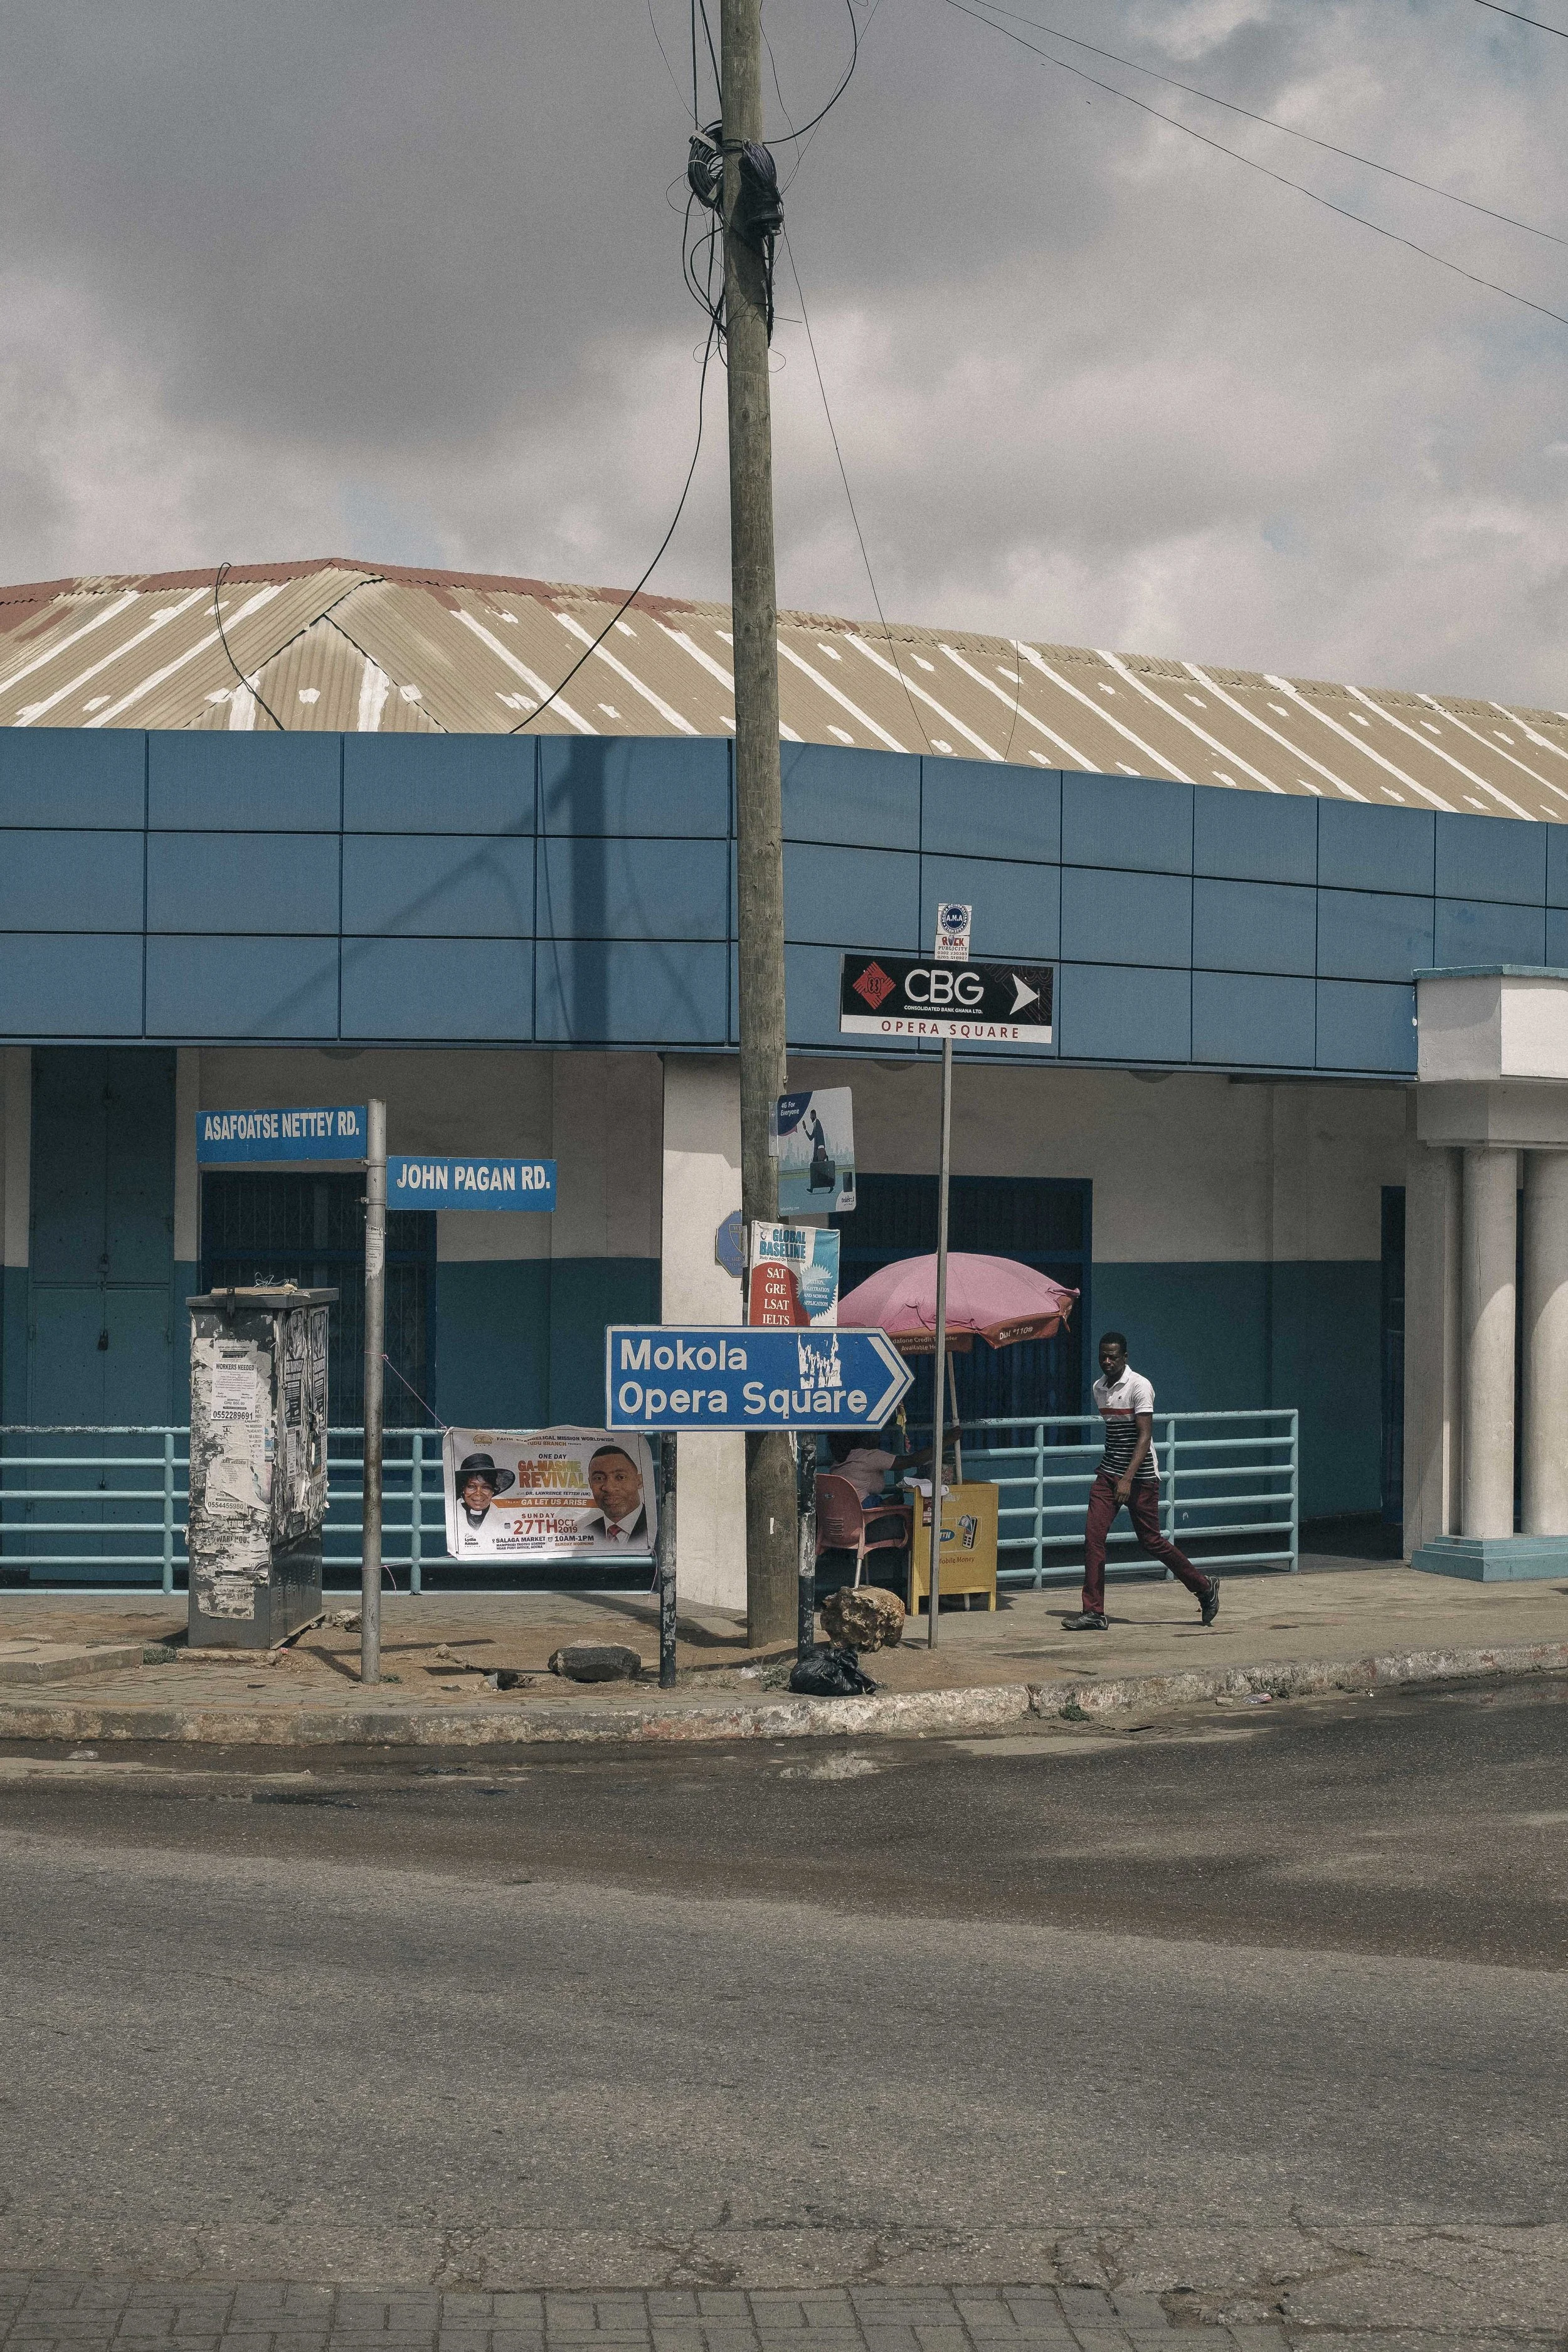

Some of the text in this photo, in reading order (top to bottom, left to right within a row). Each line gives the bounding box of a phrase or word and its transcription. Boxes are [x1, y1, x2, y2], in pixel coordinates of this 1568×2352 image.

[904, 969, 984, 1005] CBG
[881, 1020, 1019, 1039] OPERA SQUARE
[780, 1108, 800, 1116] Everyone
[204, 1111, 359, 1140] ASAFOATSE NETTEY RD.
[396, 1163, 550, 1191] JOHN PAGAN RD.
[772, 1228, 806, 1244] GLOBAL
[760, 1241, 806, 1259] BASELINE
[766, 1267, 786, 1279] SAT
[765, 1283, 787, 1295] GRE
[764, 1298, 790, 1310] LSAT
[762, 1313, 790, 1325] IELTS
[999, 1330, 1011, 1340] Dial
[620, 1338, 747, 1371] Mokola
[618, 1380, 868, 1419] Opera Square
[213, 1411, 253, 1420] 0552289691
[517, 1459, 581, 1472] GA-MASHIE
[519, 1471, 589, 1488] REVIVAL
[208, 1502, 244, 1510] 0554455980
[513, 1518, 558, 1535] 27TH
[558, 1518, 578, 1527] OCT.
